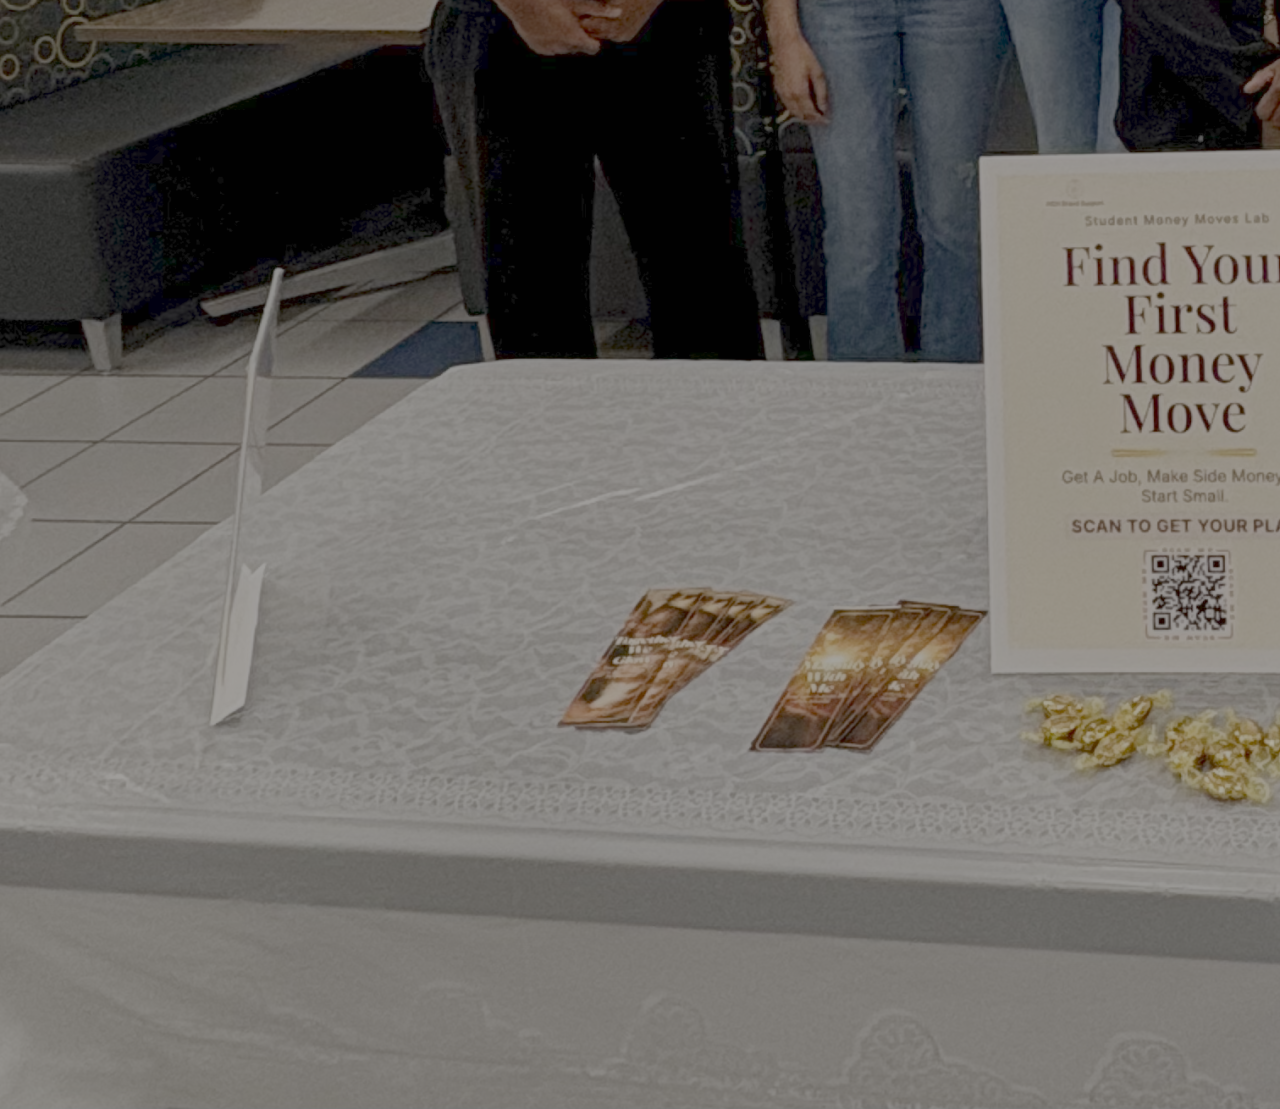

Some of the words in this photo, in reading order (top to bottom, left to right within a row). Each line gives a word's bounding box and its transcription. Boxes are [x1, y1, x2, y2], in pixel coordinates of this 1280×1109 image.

[1083, 215, 1138, 228] Student
[1143, 214, 1189, 228] Money
[1194, 213, 1239, 225] Moves
[1244, 212, 1270, 224] Lab
[1062, 241, 1170, 287] Find
[1124, 291, 1238, 335] First
[1102, 344, 1264, 393] Money
[1120, 392, 1247, 434] Move
[1061, 469, 1089, 485] Get
[1092, 469, 1105, 484] A
[1108, 469, 1142, 487] Job,
[1146, 468, 1189, 484] Make
[1193, 468, 1227, 483] Side
[1141, 488, 1179, 504] Start
[1071, 519, 1122, 534] SCAN
[1126, 518, 1152, 534] TO
[1156, 518, 1192, 534] GET
[1197, 518, 1248, 533] YOUR
